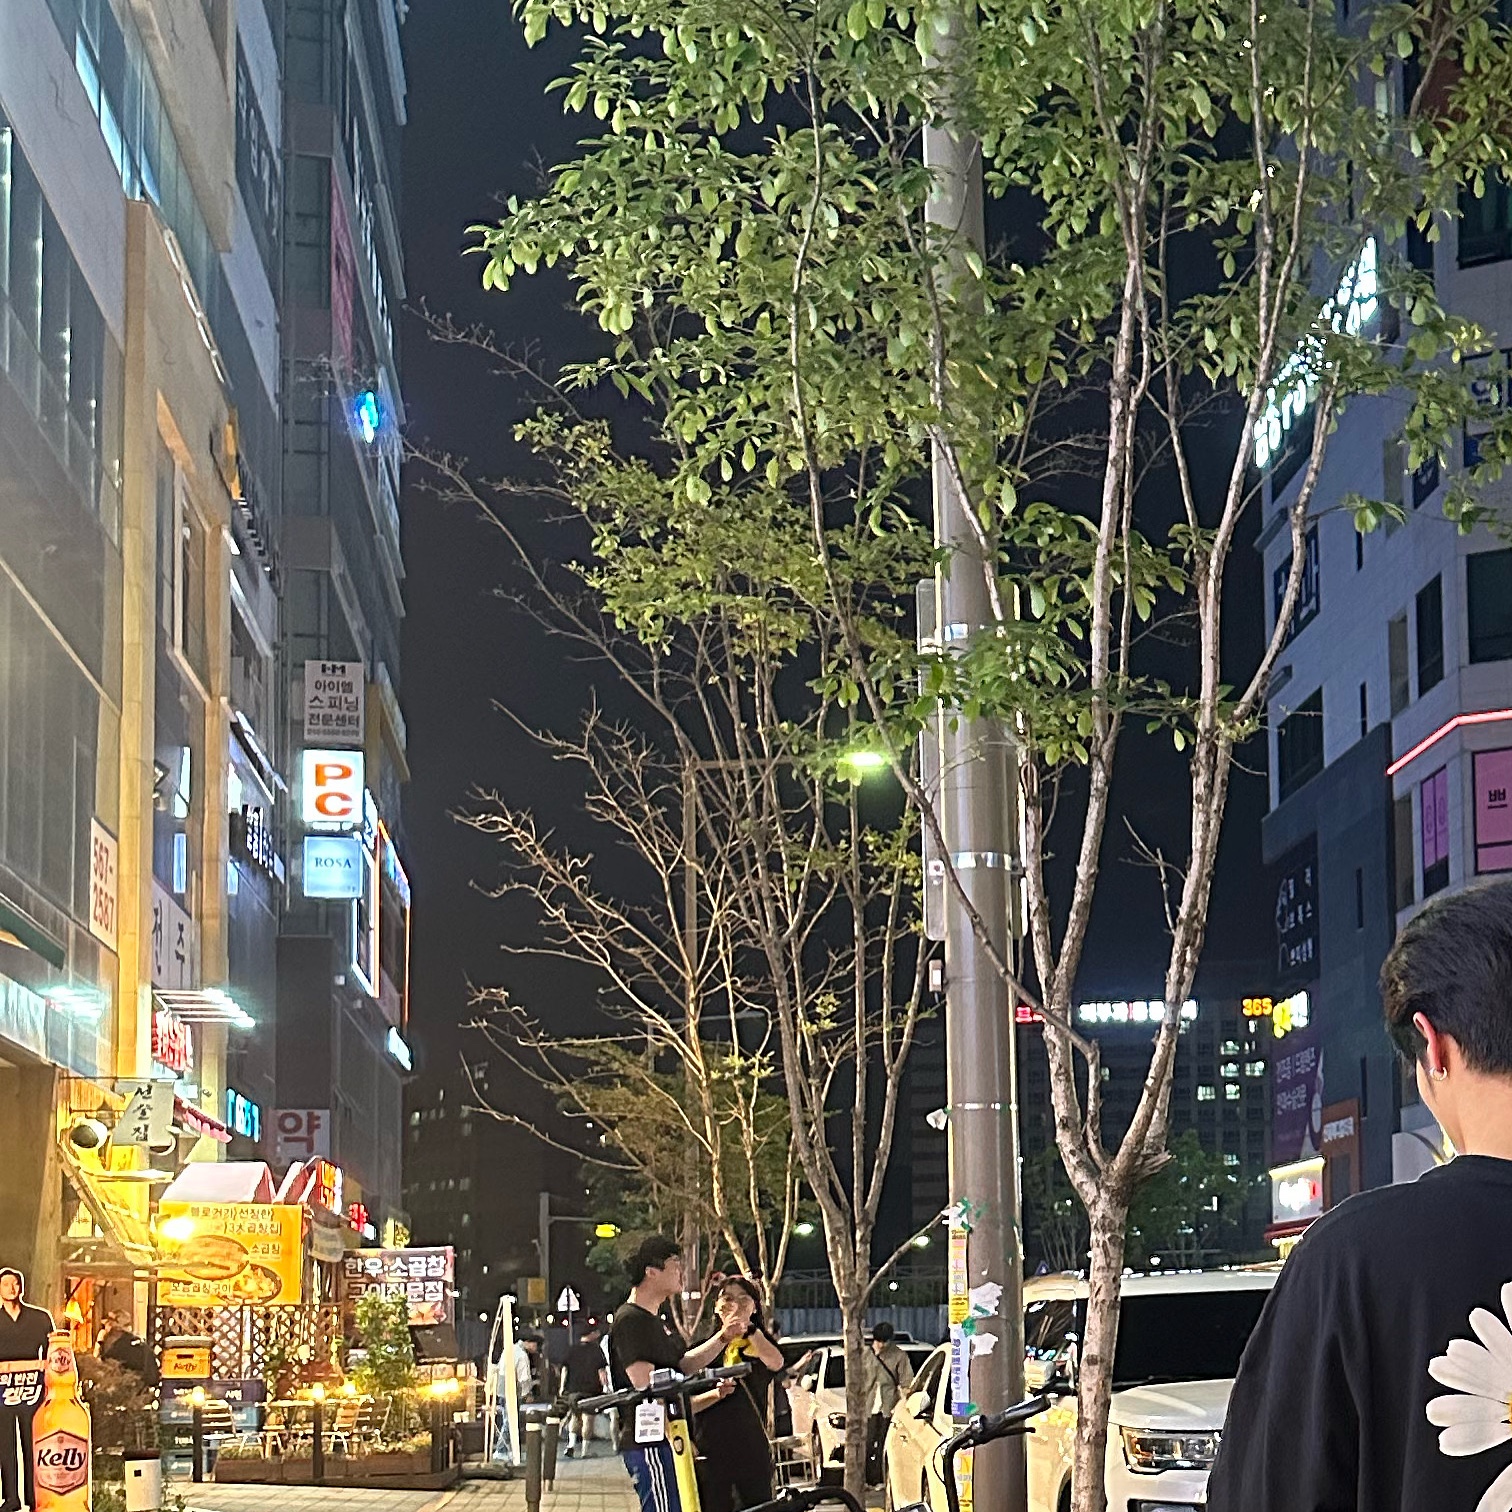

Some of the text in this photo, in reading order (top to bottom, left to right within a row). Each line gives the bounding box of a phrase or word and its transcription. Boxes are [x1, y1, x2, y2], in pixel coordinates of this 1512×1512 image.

[315, 856, 352, 868] ROSA
[1242, 997, 1273, 1016] 365
[277, 1111, 322, 1155] 약
[37, 1448, 87, 1472] Kelly
